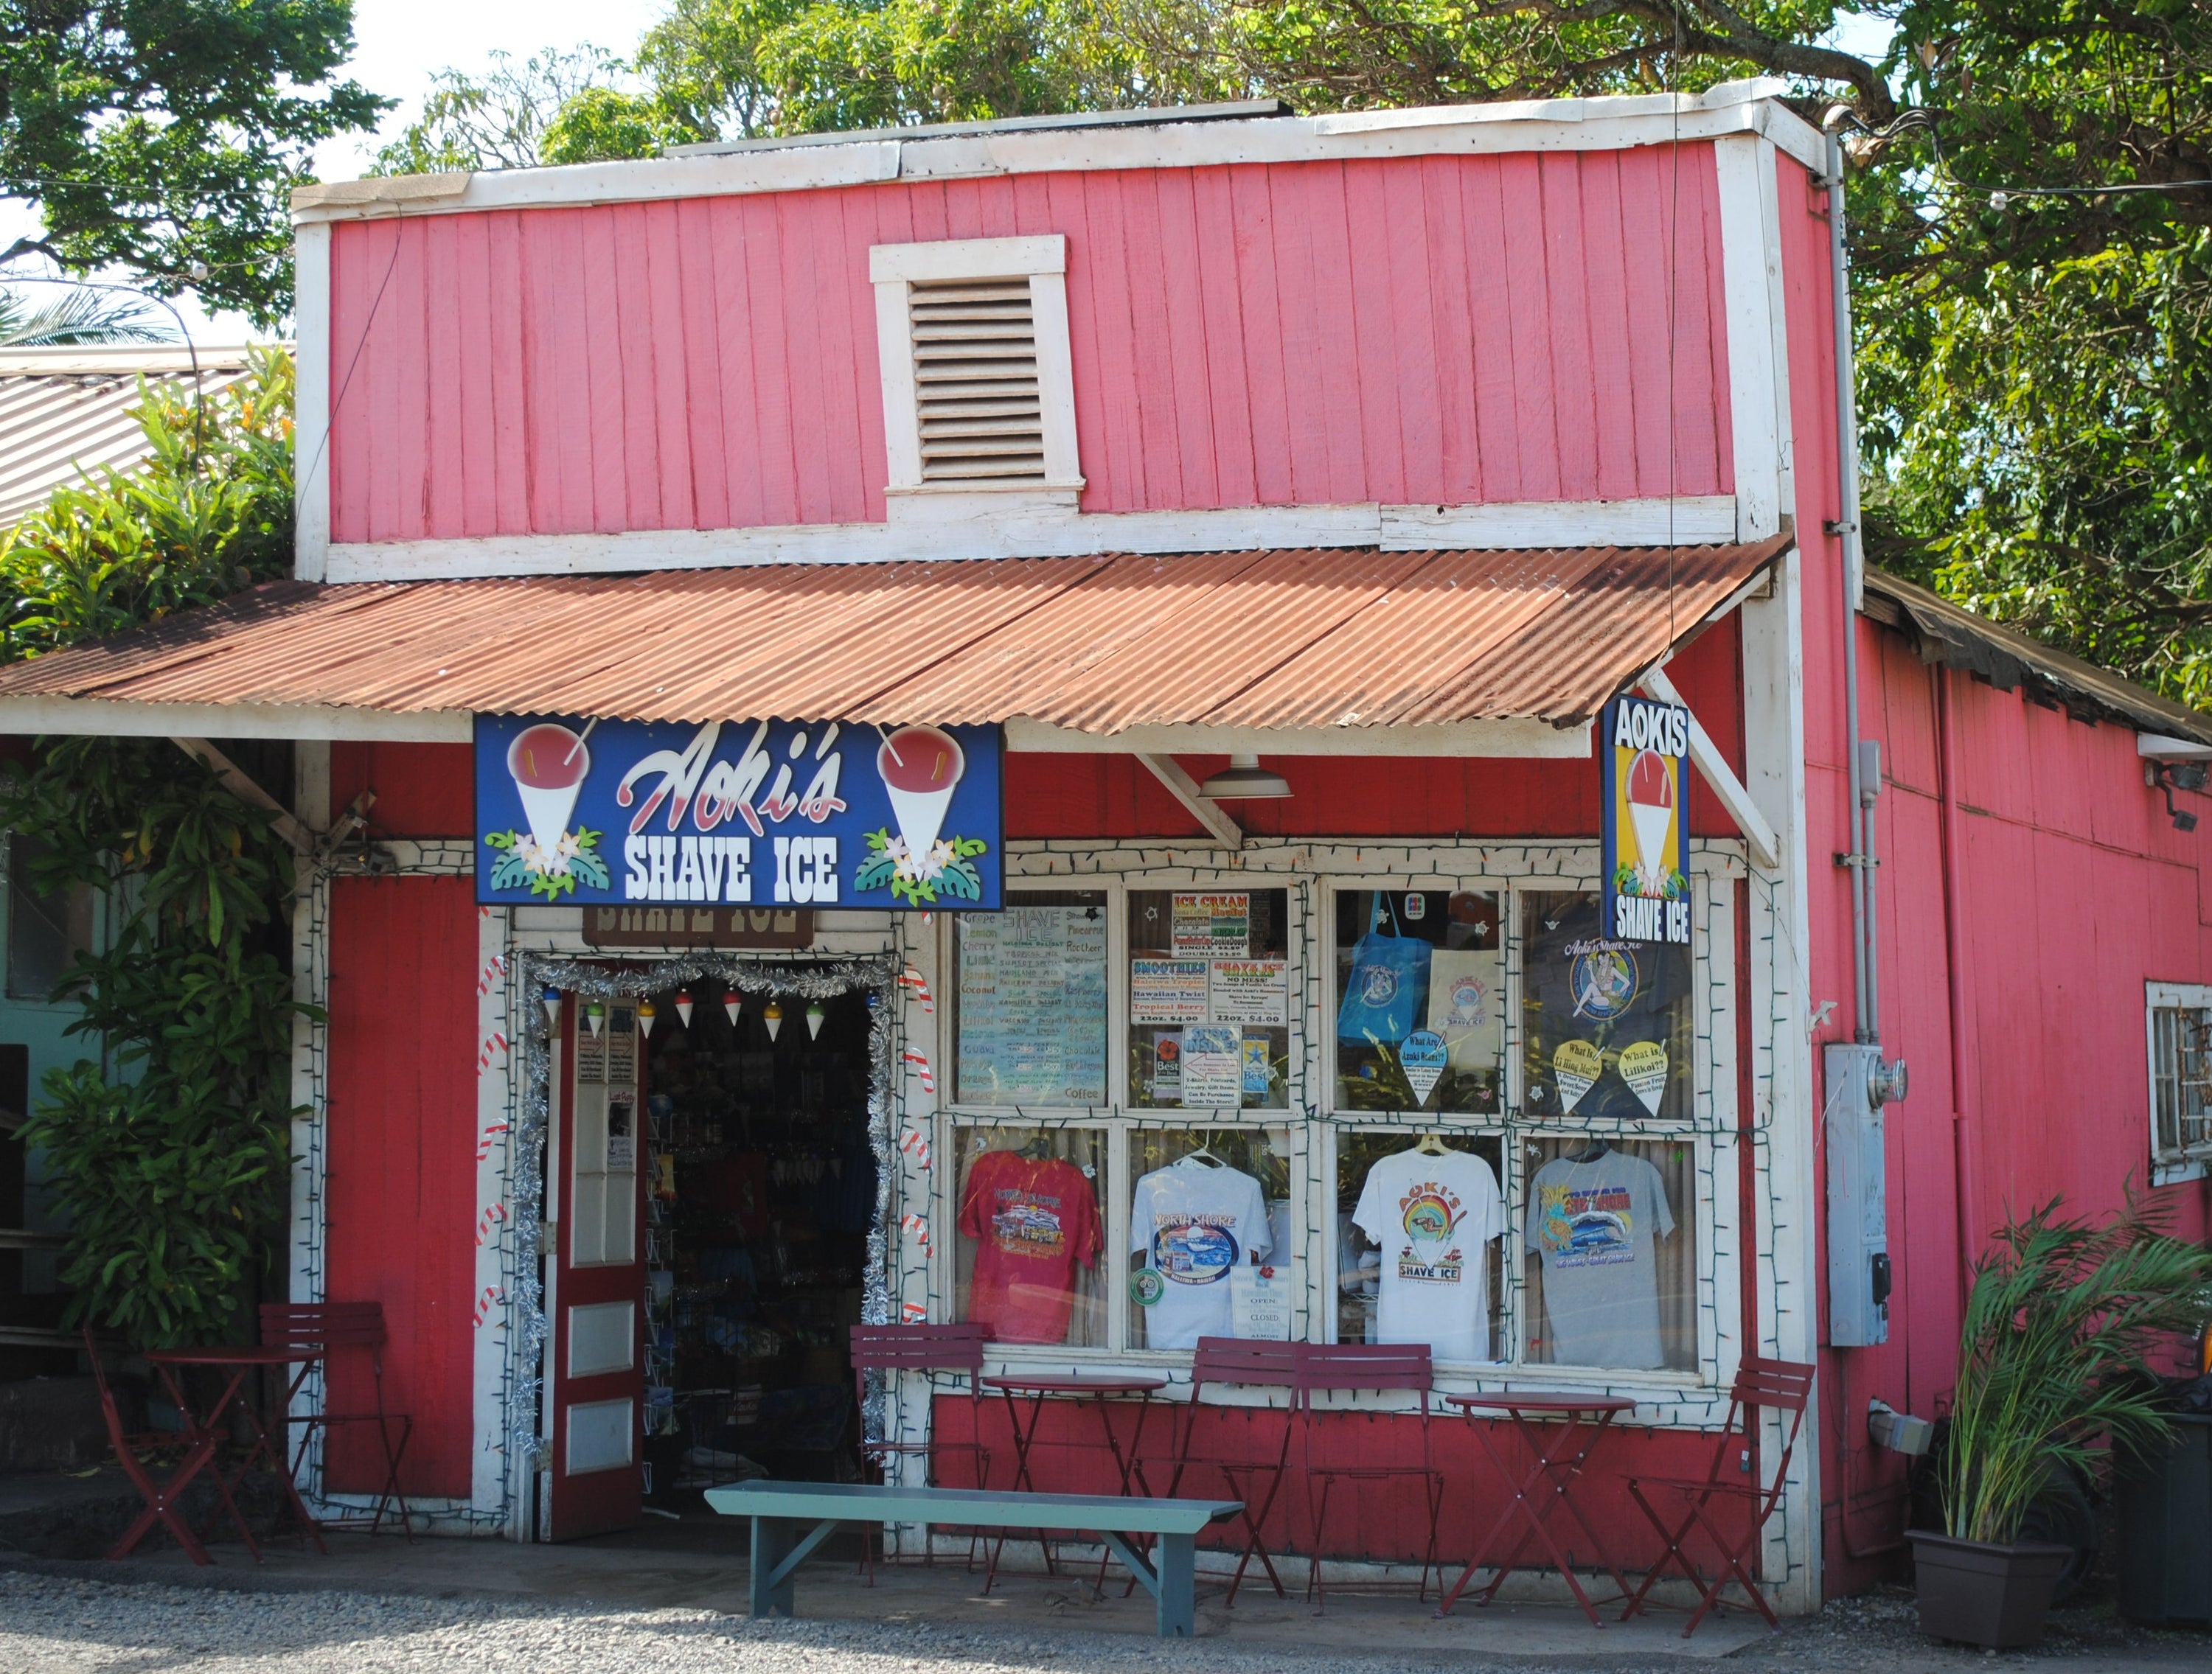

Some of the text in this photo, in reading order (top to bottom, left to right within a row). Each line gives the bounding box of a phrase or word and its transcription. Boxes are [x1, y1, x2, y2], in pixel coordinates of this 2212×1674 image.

[1615, 699, 1687, 758] AOKI'S
[619, 720, 846, 837] Aoki's
[625, 834, 838, 903] SHAVE ICE
[1174, 896, 1248, 908] ICE CREAM
[964, 913, 995, 924] Grape
[1004, 909, 1060, 927] SHAVE
[1174, 917, 1209, 926] Chocolate
[1616, 894, 1688, 944] SHAVE ICE
[967, 928, 997, 938] Lemon
[1016, 927, 1052, 943] ICE
[963, 941, 995, 952] Cherry
[1565, 940, 1597, 956] Aoki's
[1134, 962, 1206, 974] SMOOTHIES
[1214, 963, 1258, 972] SHAVE
[961, 983, 995, 995] Coconut
[1192, 1028, 1231, 1041] SHOP
[1184, 1039, 1238, 1053] INSIDE!
[1409, 1036, 1438, 1047] What Are
[964, 1045, 995, 1054] Guava
[1065, 1046, 1101, 1055] Chocolate
[1402, 1050, 1420, 1061] Azuki
[1570, 1043, 1593, 1059] What Is
[1624, 1047, 1658, 1061] What is
[1157, 1061, 1180, 1071] Best
[1555, 1056, 1562, 1067] Li
[1563, 1059, 1579, 1073] Hing
[1624, 1060, 1663, 1077] Lilikoi??
[1244, 1071, 1267, 1081] Best
[1065, 1087, 1099, 1100] Coffee
[1399, 1182, 1461, 1213] AOKI'S
[1155, 1213, 1237, 1227] NORTH SHORE
[1400, 1265, 1458, 1279] SHAVE ICE
